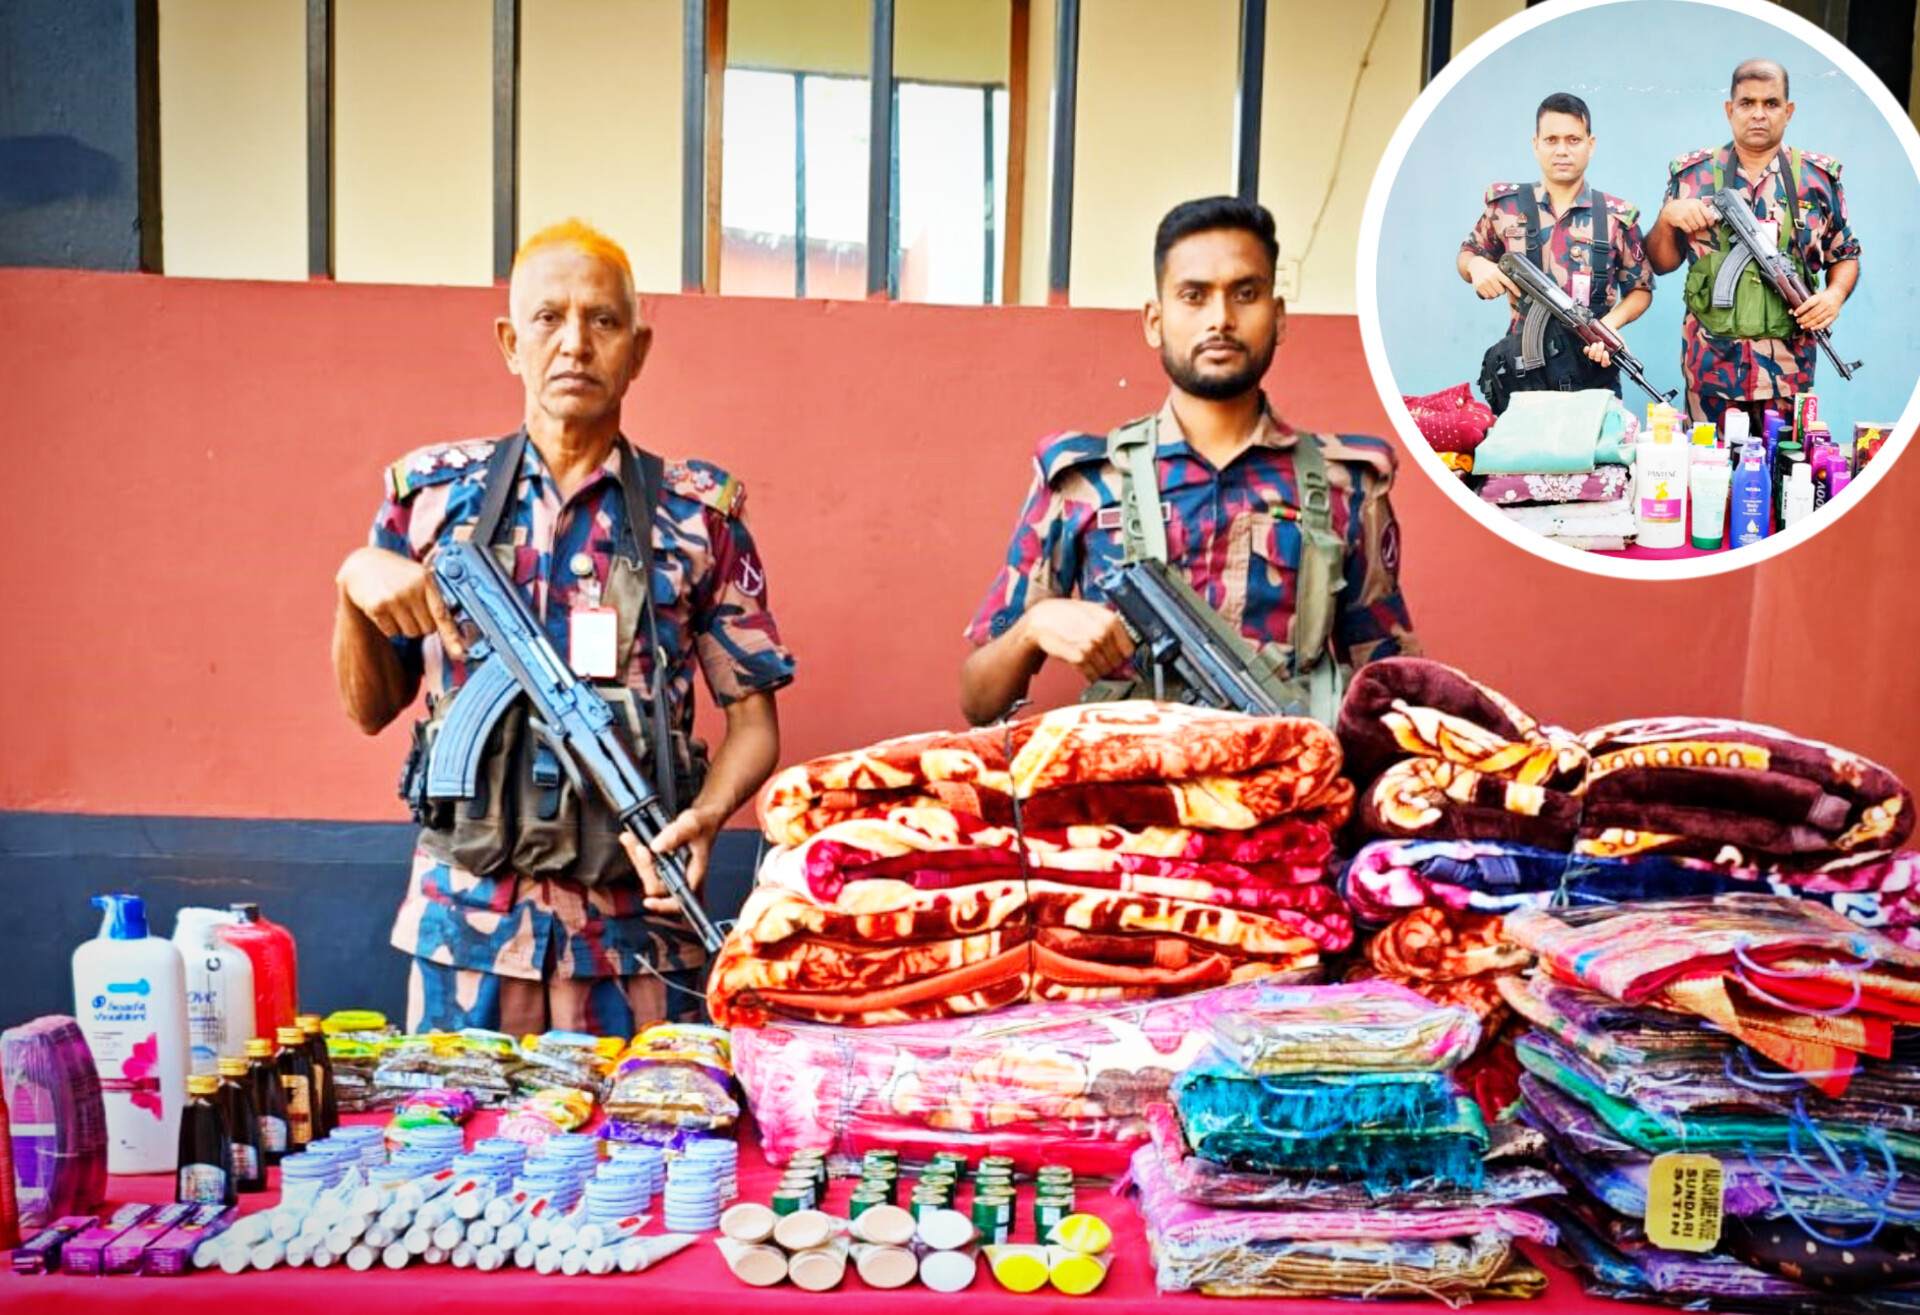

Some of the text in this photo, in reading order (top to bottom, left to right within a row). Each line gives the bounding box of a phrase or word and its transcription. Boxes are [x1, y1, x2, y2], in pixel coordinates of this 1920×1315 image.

[1806, 398, 1817, 421] Colg
[1647, 470, 1677, 478] PANTENE
[1669, 1167, 1684, 1236] SATIN
[1682, 1167, 1698, 1237] SUNDARI
